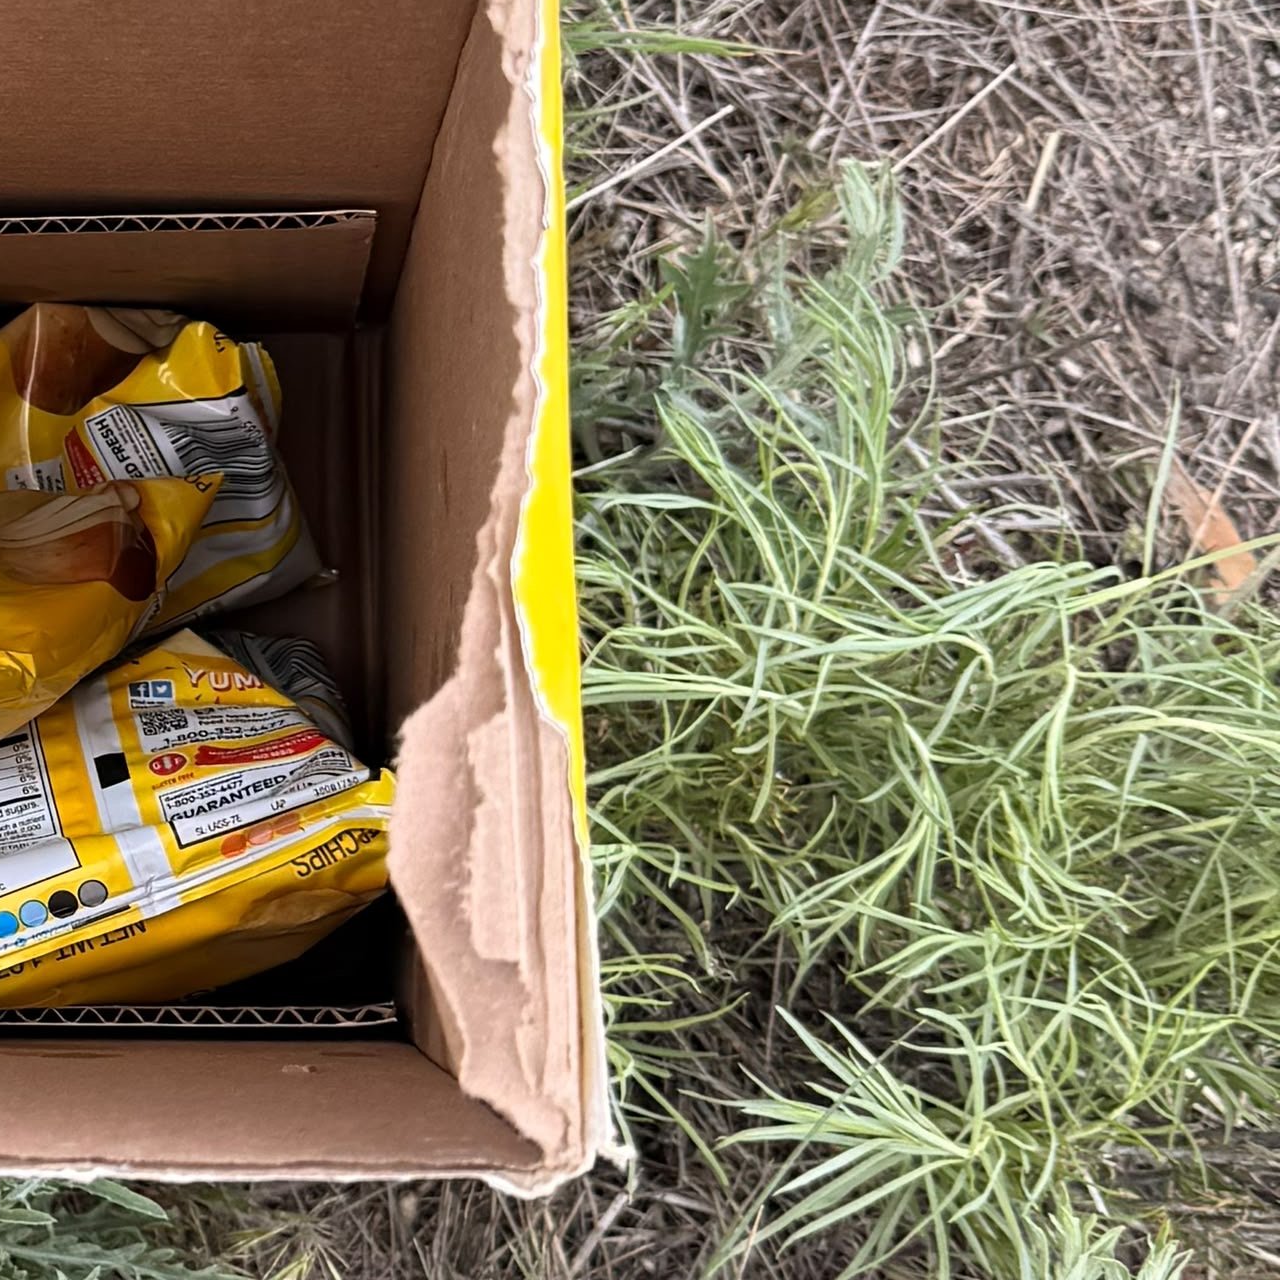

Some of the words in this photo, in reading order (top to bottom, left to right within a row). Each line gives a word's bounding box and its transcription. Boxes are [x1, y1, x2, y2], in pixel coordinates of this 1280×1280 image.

[94, 417, 131, 463] FRESH
[182, 663, 264, 691] YUM
[12, 742, 29, 751] 0%
[15, 753, 32, 764] 0%
[19, 773, 36, 783] 6%
[21, 784, 39, 794] 6%
[167, 771, 287, 823] GUARANTEED
[4, 800, 39, 816] sugars.
[290, 830, 359, 878] CHIPS
